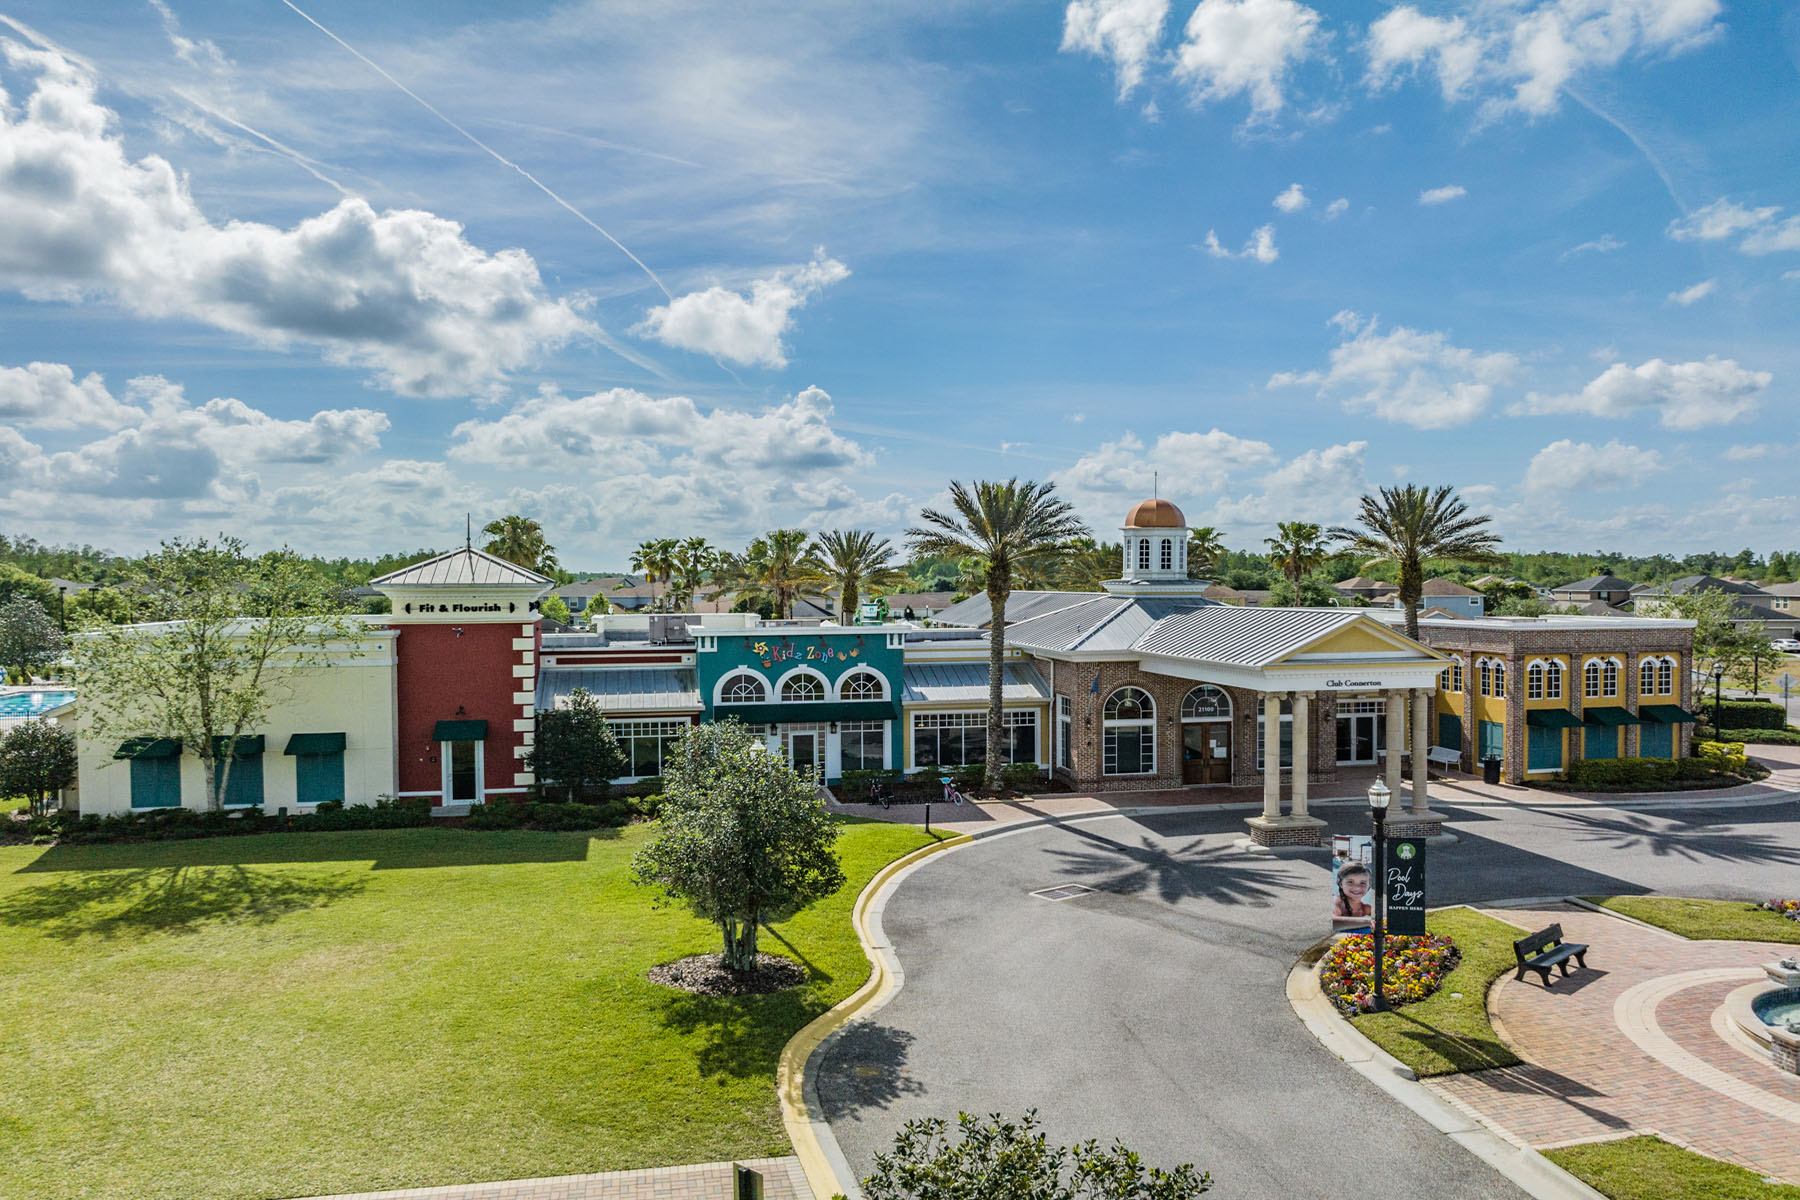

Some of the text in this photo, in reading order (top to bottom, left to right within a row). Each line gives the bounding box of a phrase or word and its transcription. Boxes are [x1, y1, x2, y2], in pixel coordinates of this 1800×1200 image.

[419, 602, 502, 612] Fit & Flourish
[771, 642, 834, 664] Kidz Zone
[1388, 866, 1412, 884] Pool
[1392, 883, 1424, 906] Days
